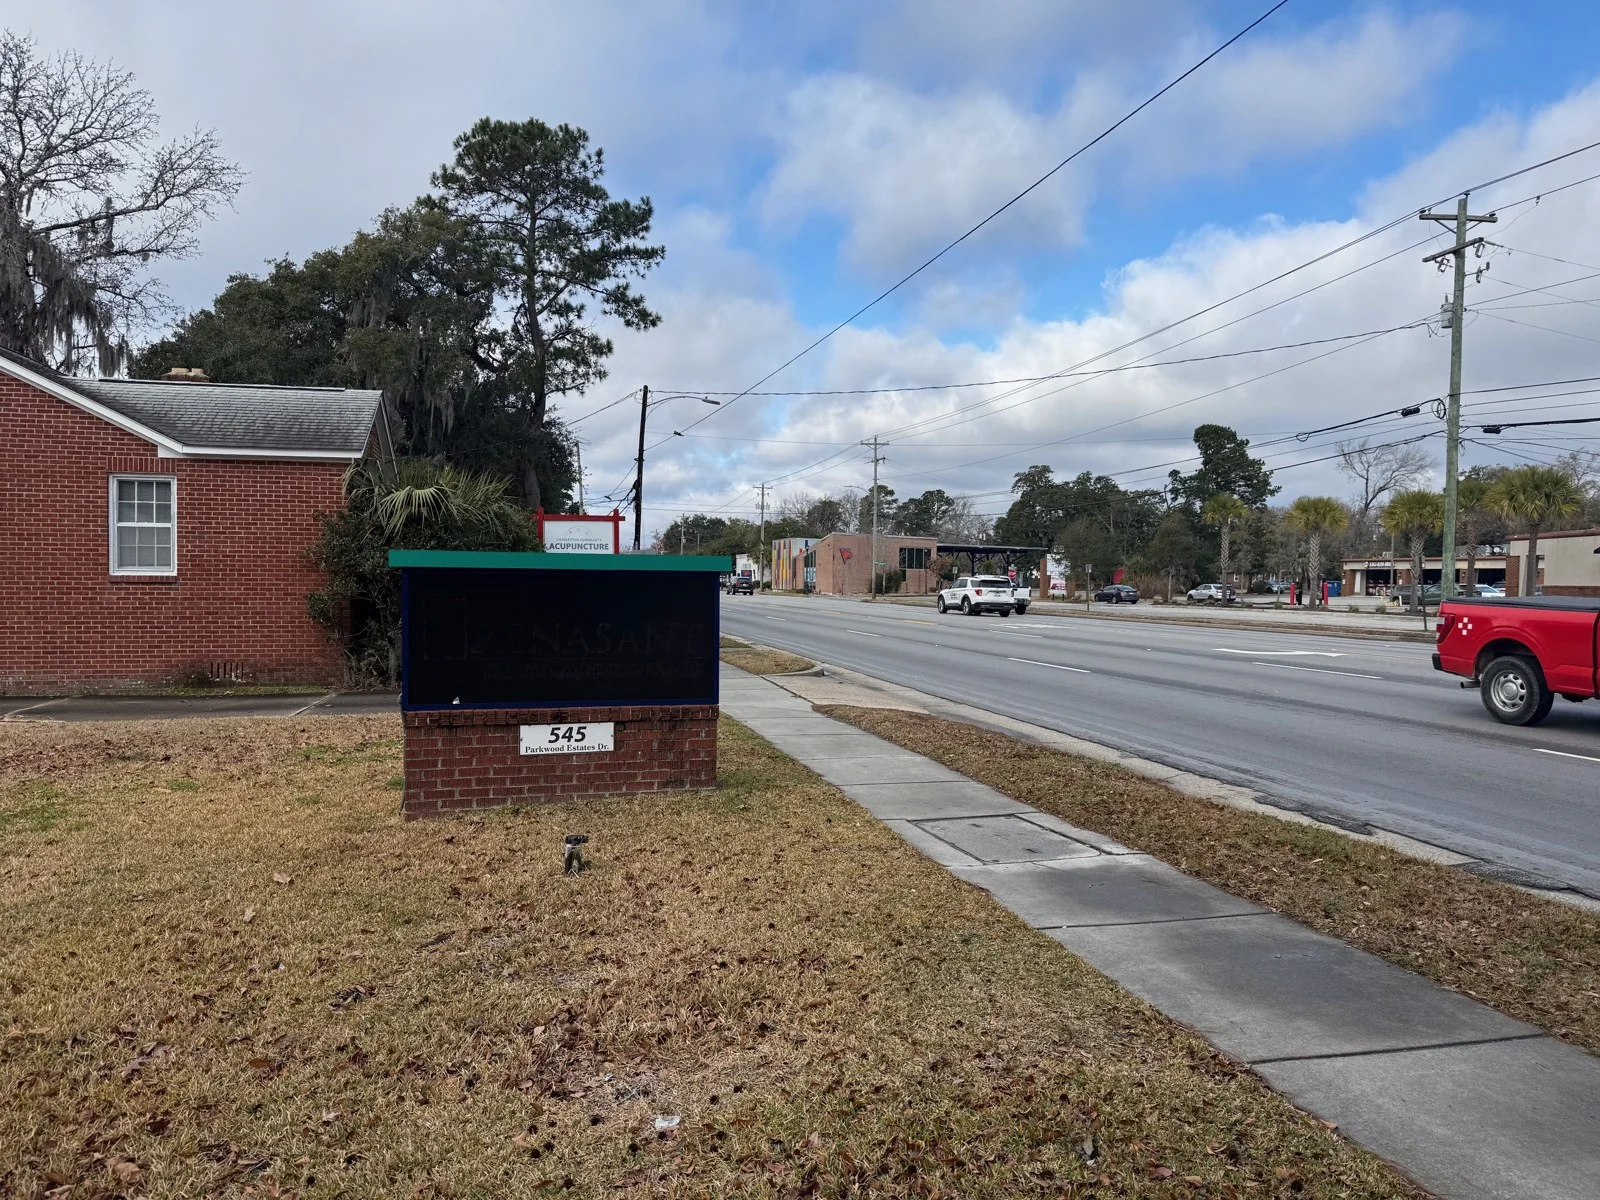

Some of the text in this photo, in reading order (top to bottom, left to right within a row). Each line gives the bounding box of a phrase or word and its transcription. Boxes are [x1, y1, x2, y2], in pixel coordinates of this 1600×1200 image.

[549, 542, 609, 550] ACUPUNCTURE
[548, 726, 587, 743] 545
[525, 745, 565, 753] Parkwood
